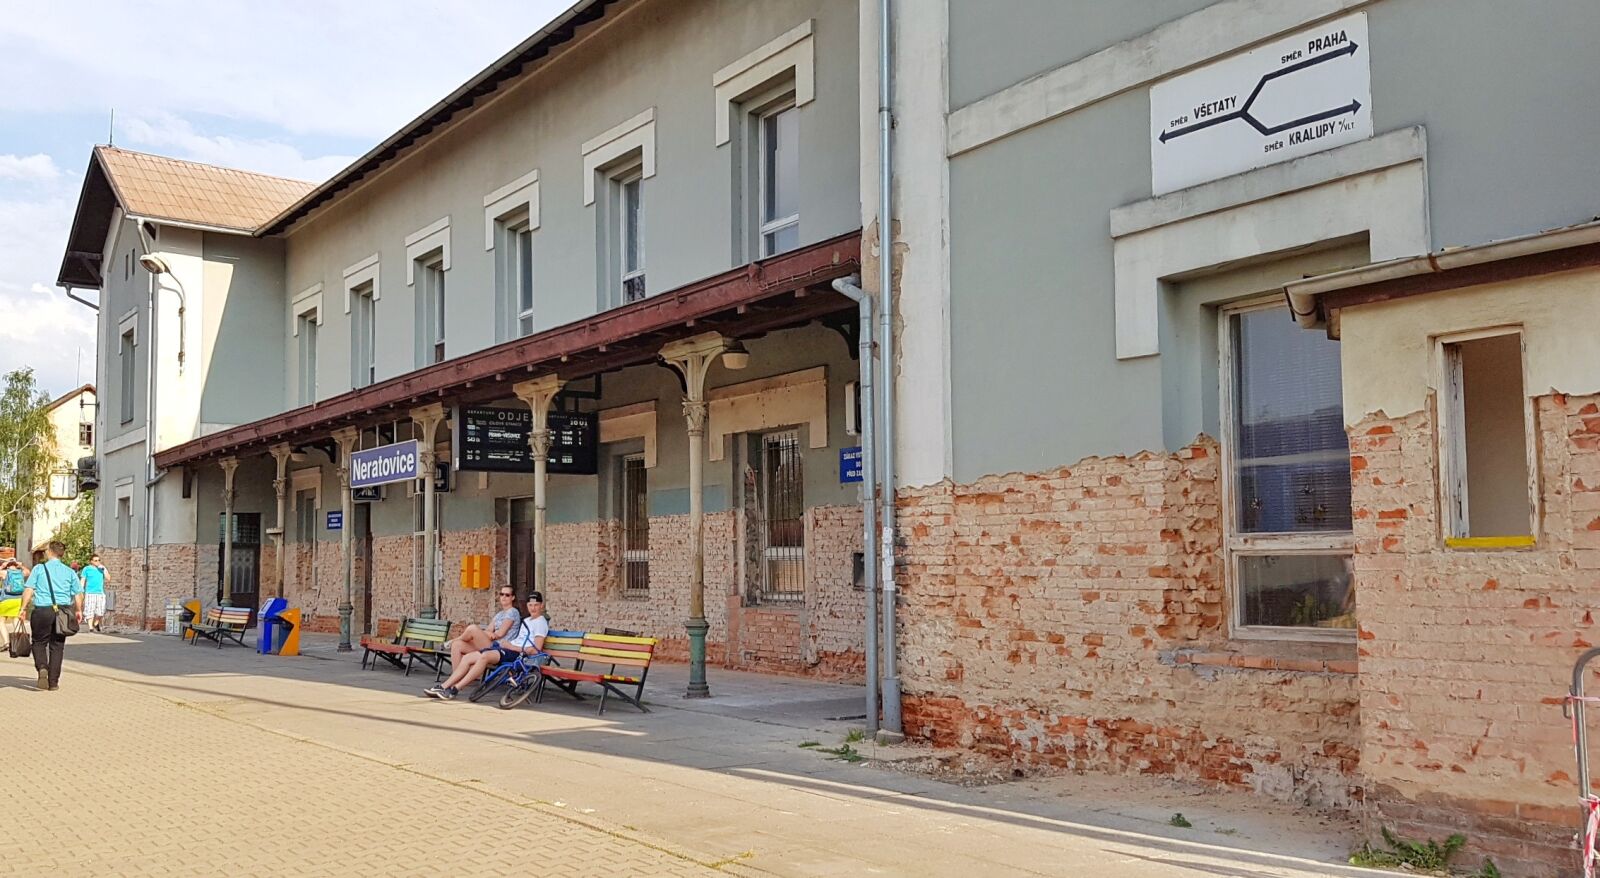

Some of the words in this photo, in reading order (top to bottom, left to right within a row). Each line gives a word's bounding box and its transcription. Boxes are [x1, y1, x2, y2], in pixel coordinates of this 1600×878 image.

[1281, 50, 1302, 64] SMĚR
[1308, 30, 1348, 54] PRAHA
[1193, 95, 1237, 119] VŠETATY
[1289, 121, 1336, 146] KRALUPY
[498, 411, 532, 421] ODJE
[352, 449, 415, 481] Neratovice
